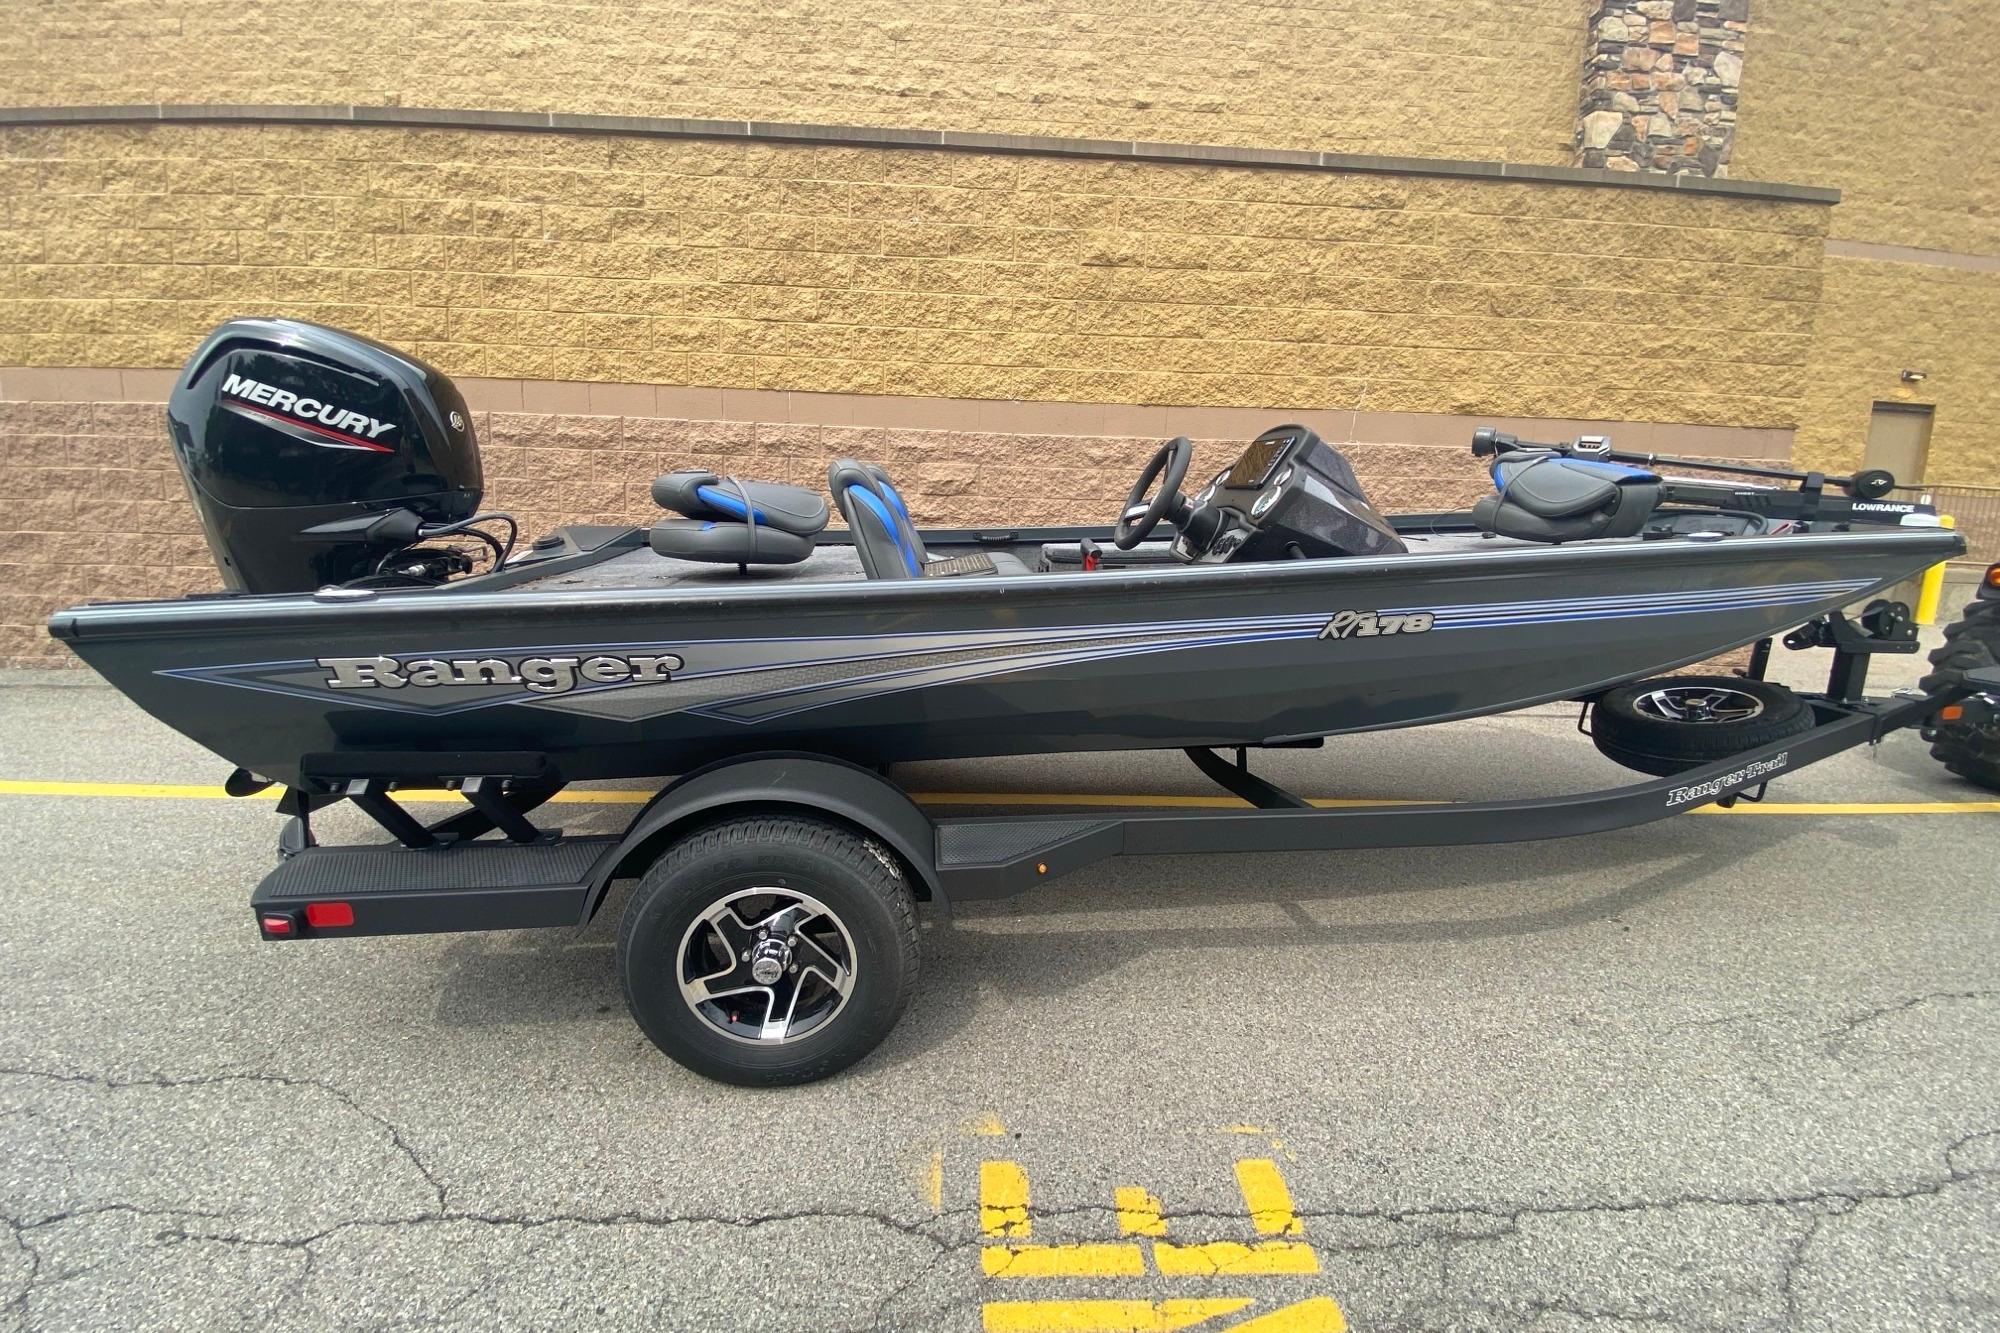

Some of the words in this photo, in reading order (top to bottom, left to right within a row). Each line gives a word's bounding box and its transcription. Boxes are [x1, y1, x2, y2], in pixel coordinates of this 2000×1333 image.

[222, 374, 396, 438] MERCURY
[1852, 503, 1914, 513] LOWRANCE
[316, 654, 684, 693] Ranger
[1666, 769, 1746, 806] Ranger
[1746, 752, 1788, 779] Trail
